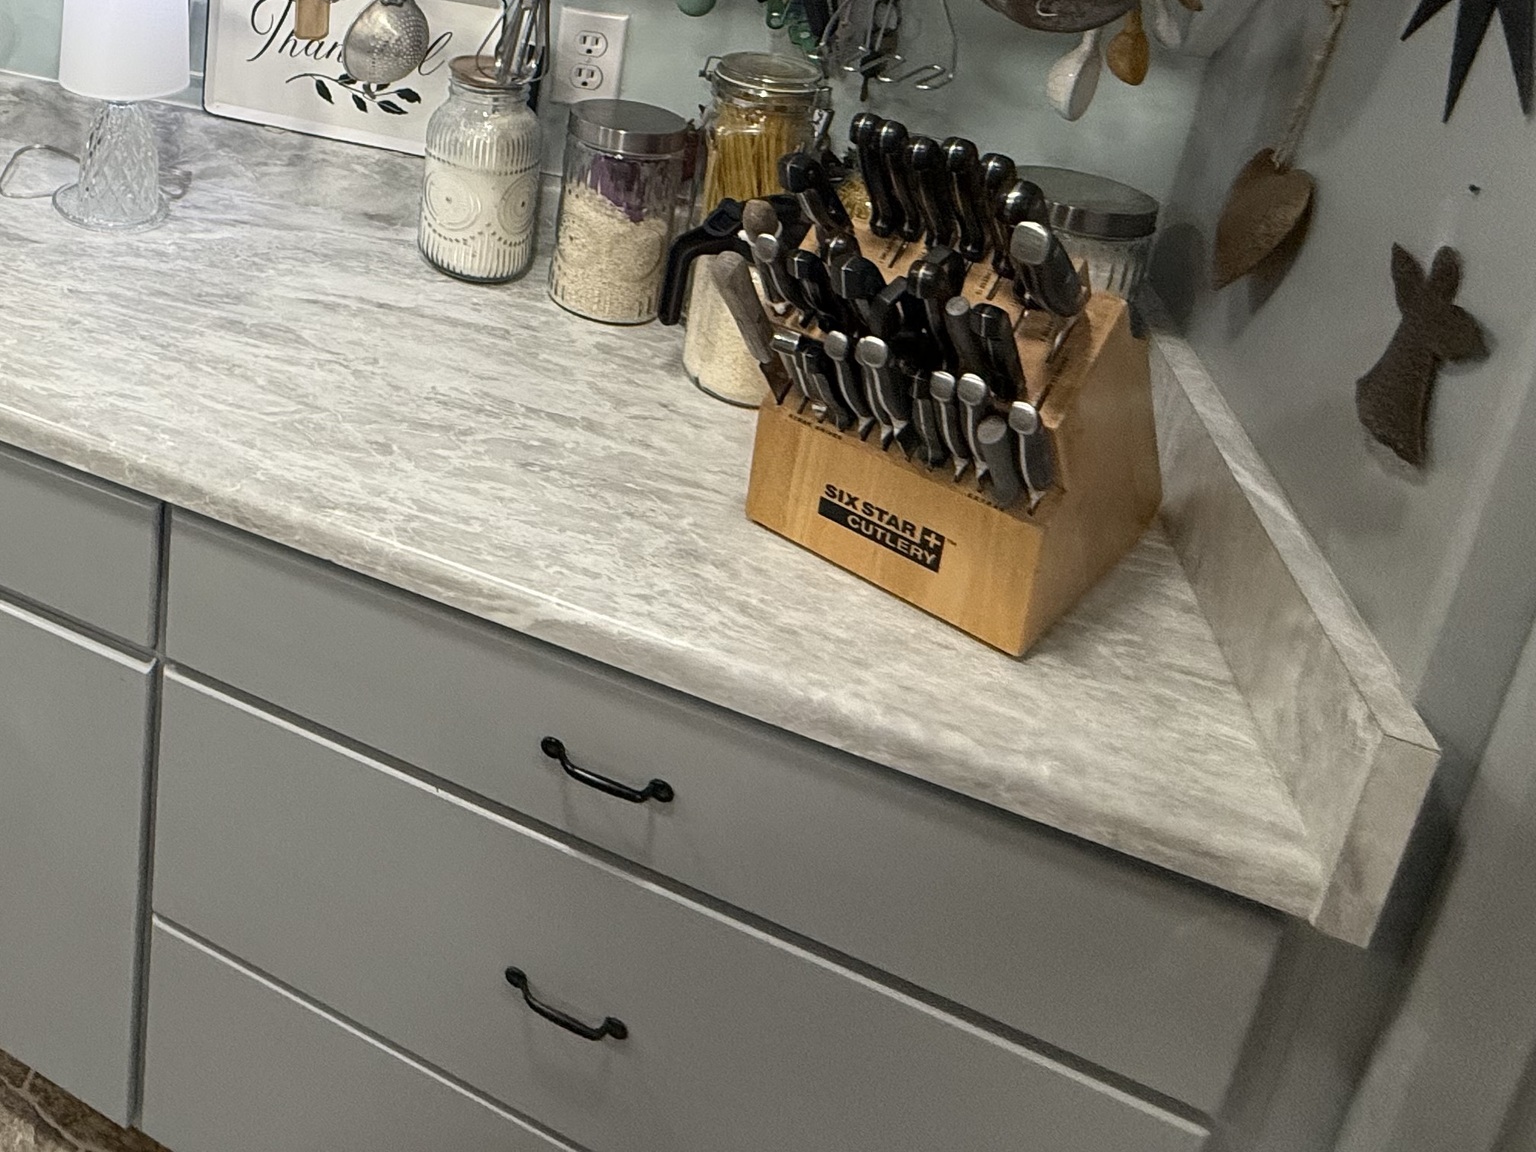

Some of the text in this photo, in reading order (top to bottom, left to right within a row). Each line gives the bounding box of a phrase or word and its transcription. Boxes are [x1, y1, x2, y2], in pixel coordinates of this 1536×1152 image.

[824, 483, 859, 511] SIX
[860, 501, 917, 537] STAR
[846, 514, 937, 566] CUTLERY
